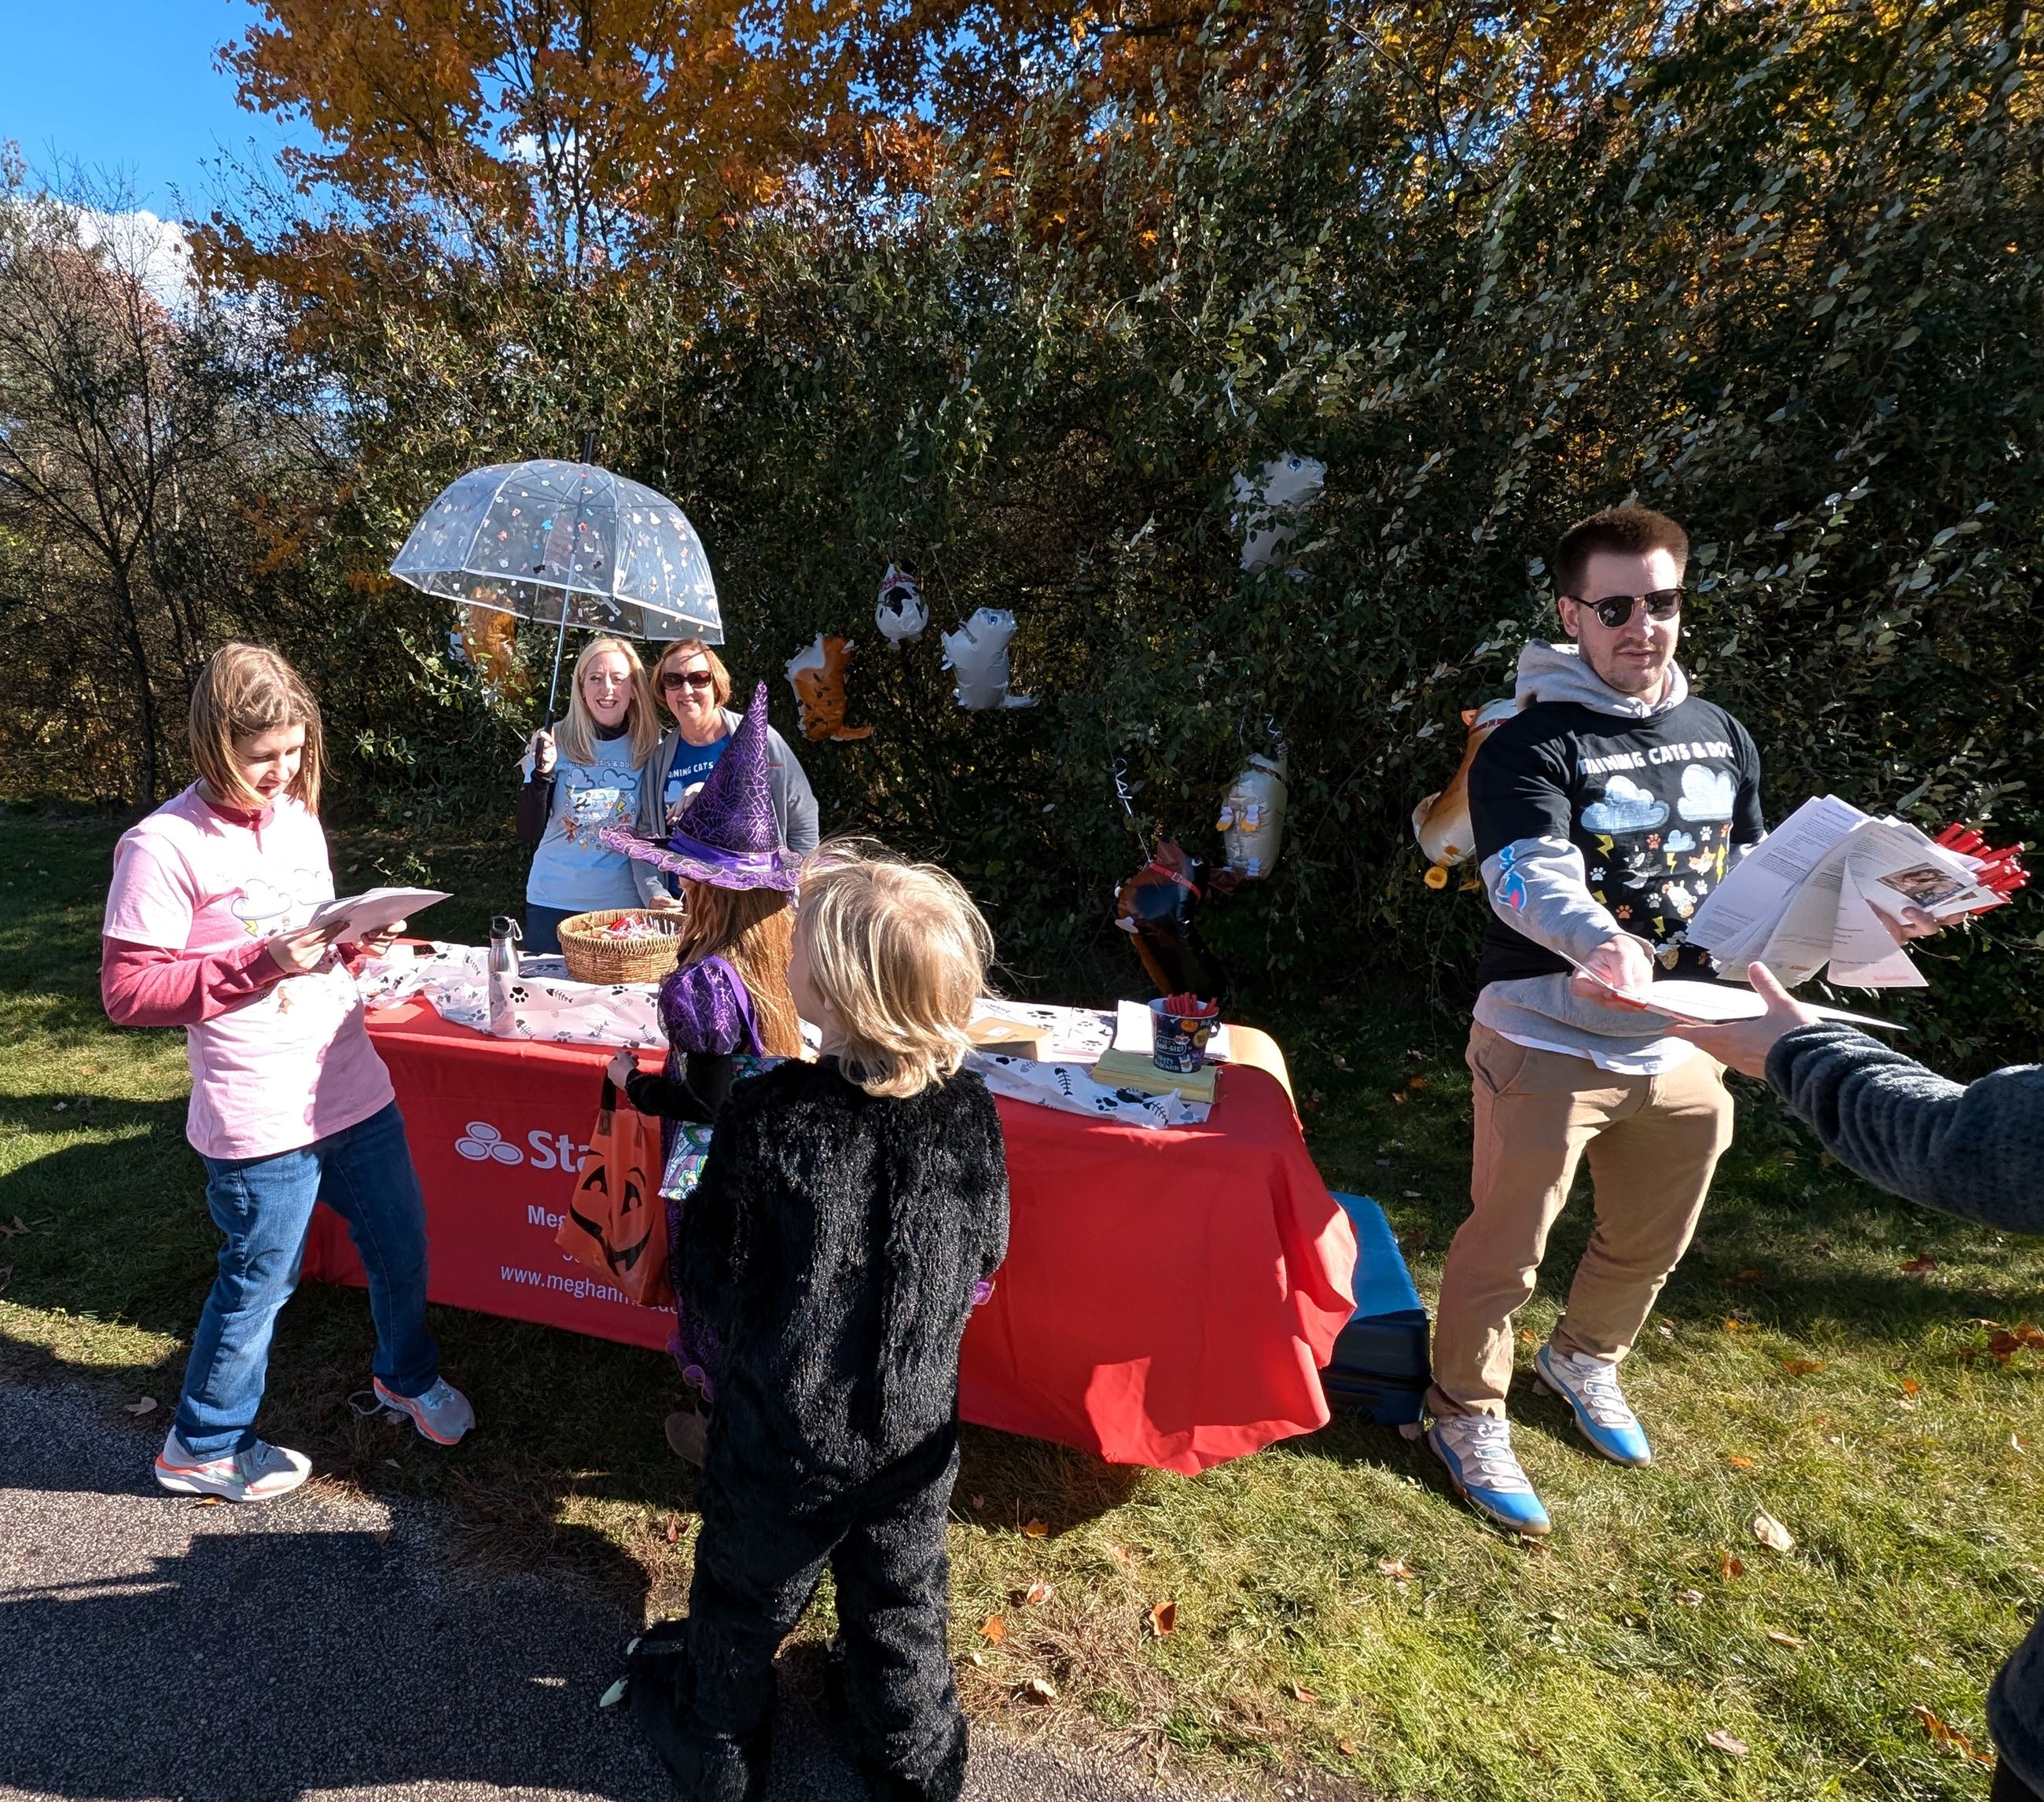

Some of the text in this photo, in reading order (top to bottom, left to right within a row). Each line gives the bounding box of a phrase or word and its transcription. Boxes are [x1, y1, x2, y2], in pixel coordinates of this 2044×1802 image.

[1649, 743, 1691, 765] CATS
[1691, 741, 1708, 759] &
[693, 761, 714, 773] CATS
